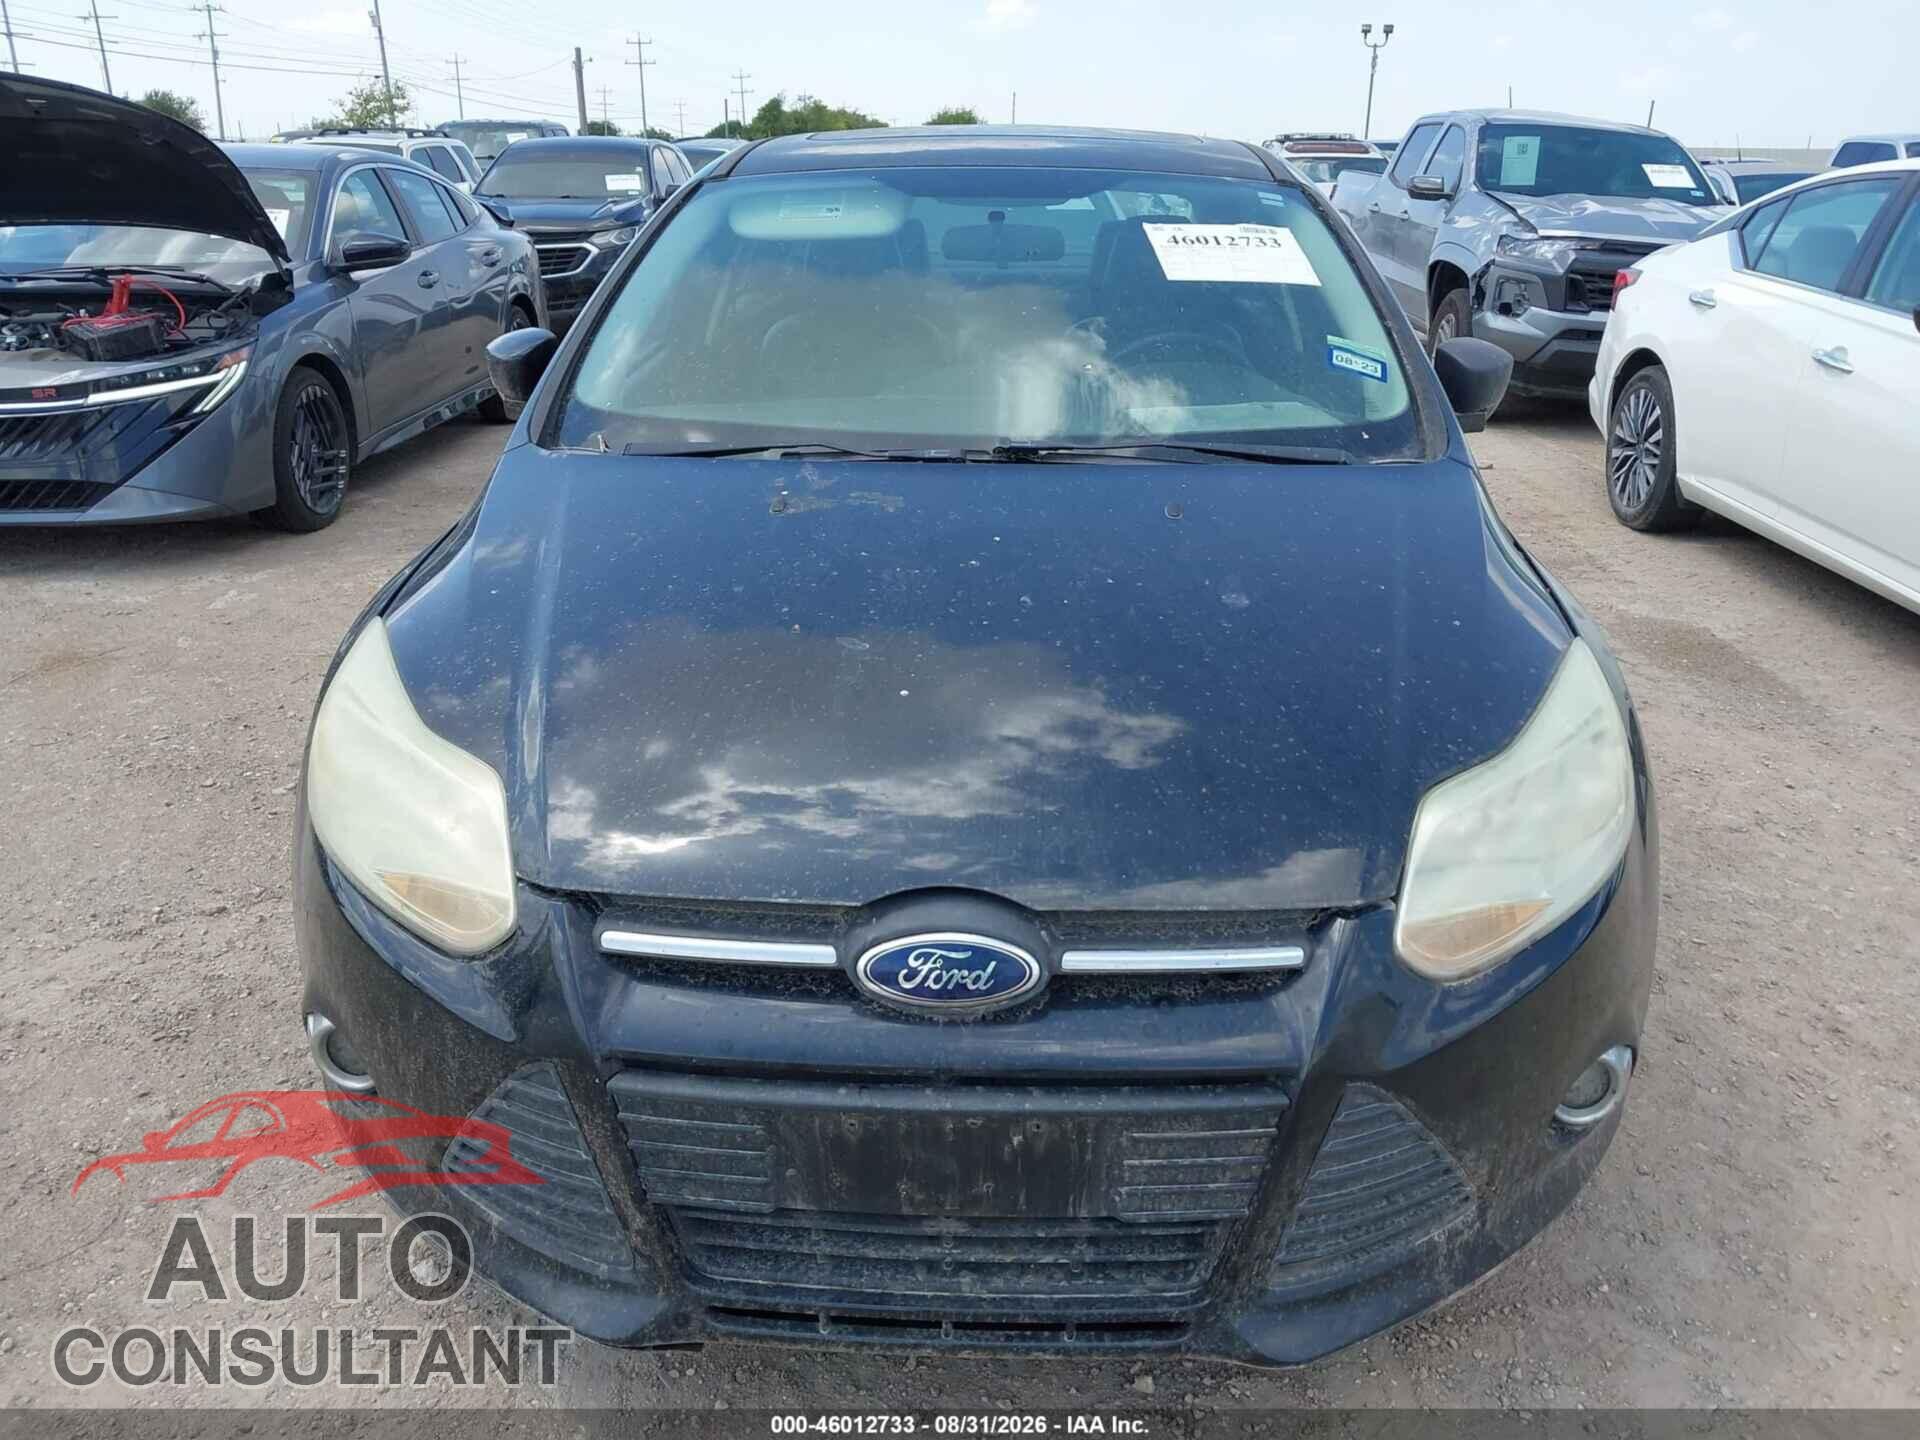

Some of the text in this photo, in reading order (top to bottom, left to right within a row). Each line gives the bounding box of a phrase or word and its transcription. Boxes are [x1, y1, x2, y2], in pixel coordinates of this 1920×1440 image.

[1166, 234, 1282, 249] 46012733
[31, 387, 56, 399] SR
[898, 948, 997, 989] Ford
